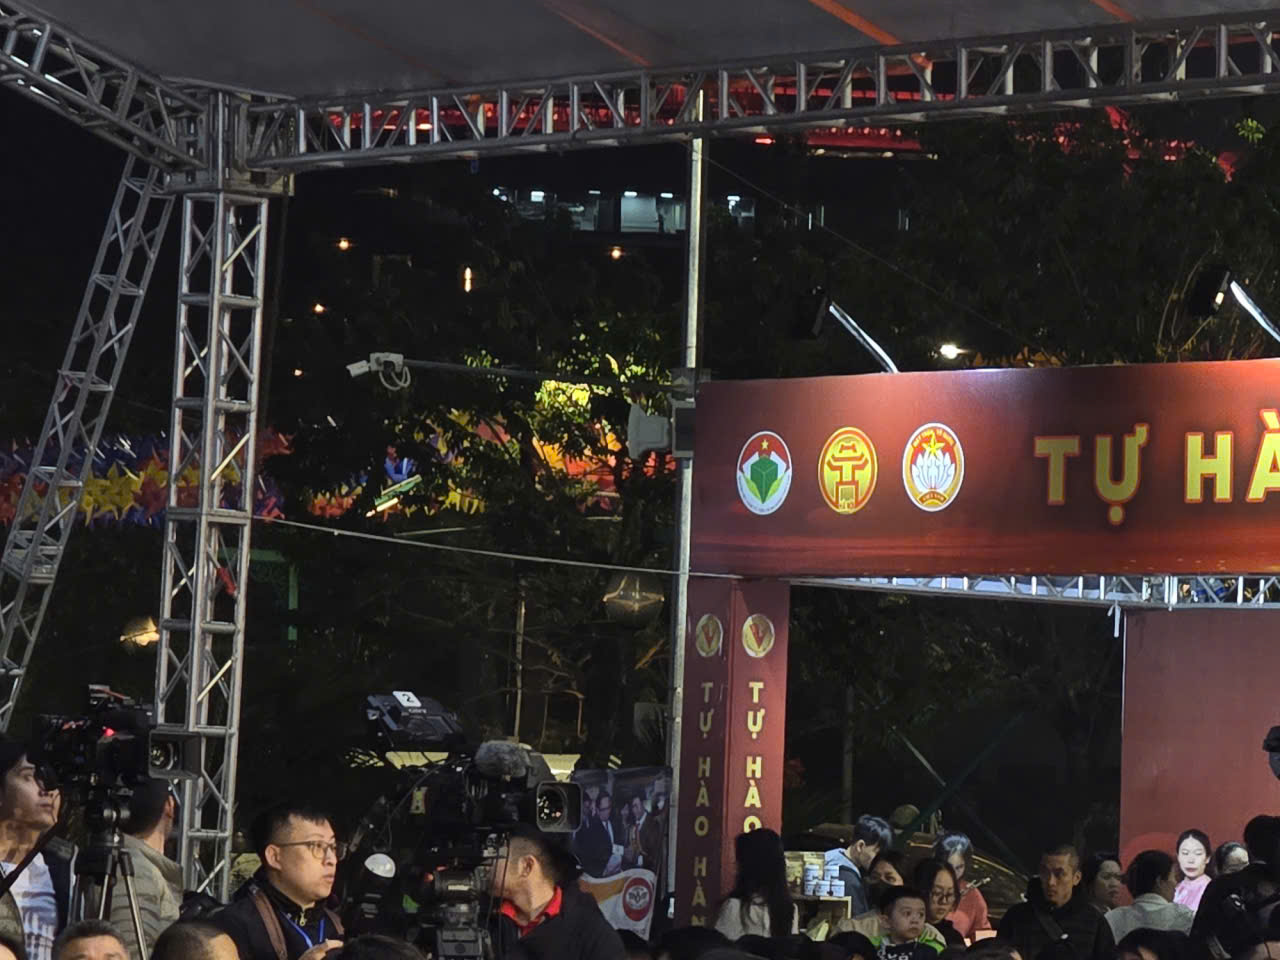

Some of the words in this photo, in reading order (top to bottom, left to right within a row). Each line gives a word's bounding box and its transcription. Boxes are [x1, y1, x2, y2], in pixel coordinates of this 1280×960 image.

[1034, 423, 1149, 526] TỰ
[699, 682, 714, 739] TỰ
[747, 681, 766, 739] TỰ
[694, 756, 711, 836] HÀO
[691, 856, 707, 927] HÀN
